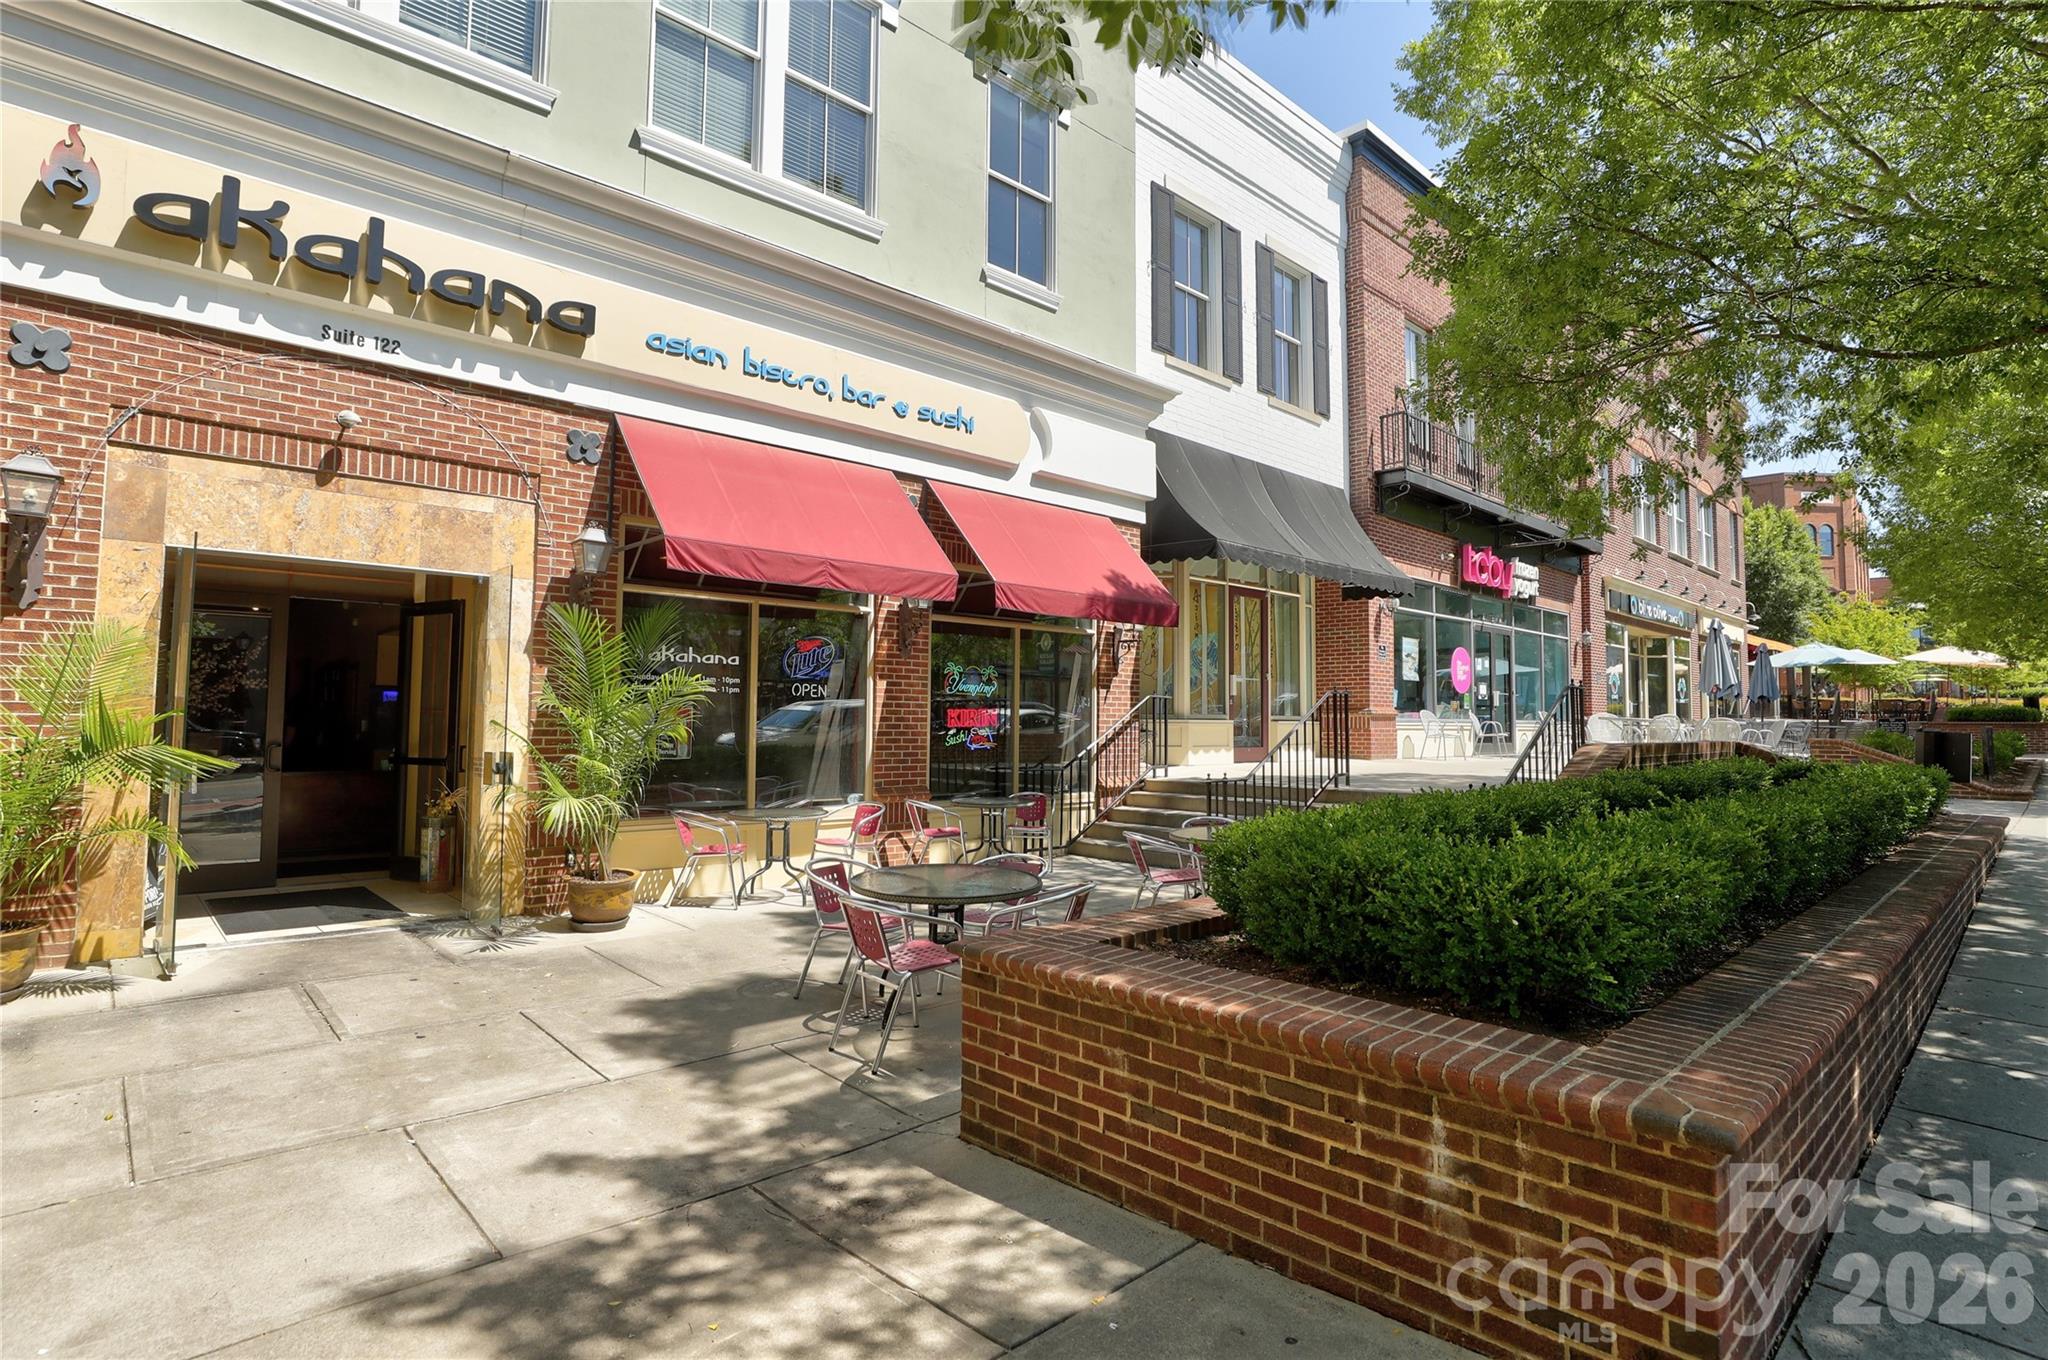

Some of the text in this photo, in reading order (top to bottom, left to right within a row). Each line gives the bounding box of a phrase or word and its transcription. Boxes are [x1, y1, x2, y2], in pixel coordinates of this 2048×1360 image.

[321, 324, 401, 355] Suite 122
[645, 332, 975, 434] asian bistro, bar sushi
[722, 676, 740, 685] 10pm
[721, 686, 740, 695] 11pm
[791, 683, 827, 698] OPEN
